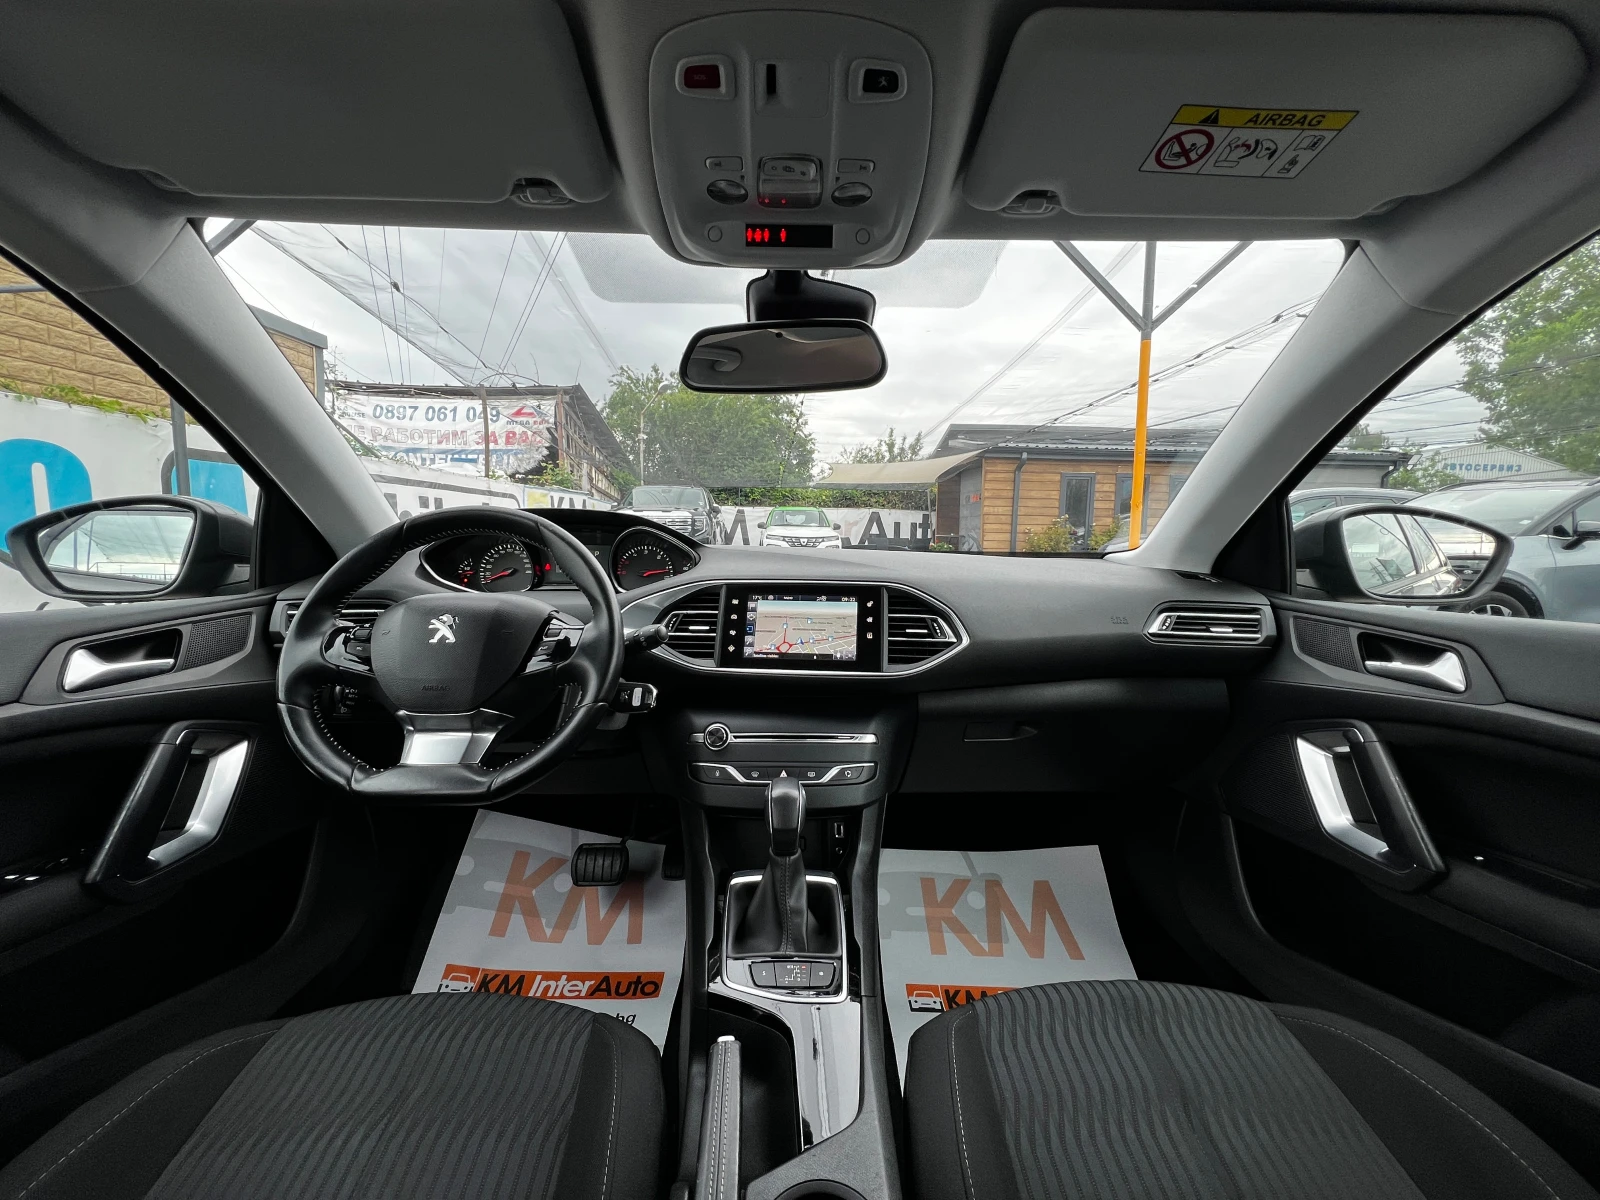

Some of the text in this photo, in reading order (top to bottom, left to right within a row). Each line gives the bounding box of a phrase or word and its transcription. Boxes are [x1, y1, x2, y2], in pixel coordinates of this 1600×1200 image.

[1244, 113, 1326, 127] AIRBAG
[372, 403, 419, 421] 0897
[424, 405, 458, 422] 061
[370, 426, 468, 446] РАБОТИМ
[474, 430, 499, 446] ЗА
[488, 850, 645, 946] KM
[919, 876, 1086, 961] KM
[477, 973, 660, 998] KM InterAuto
